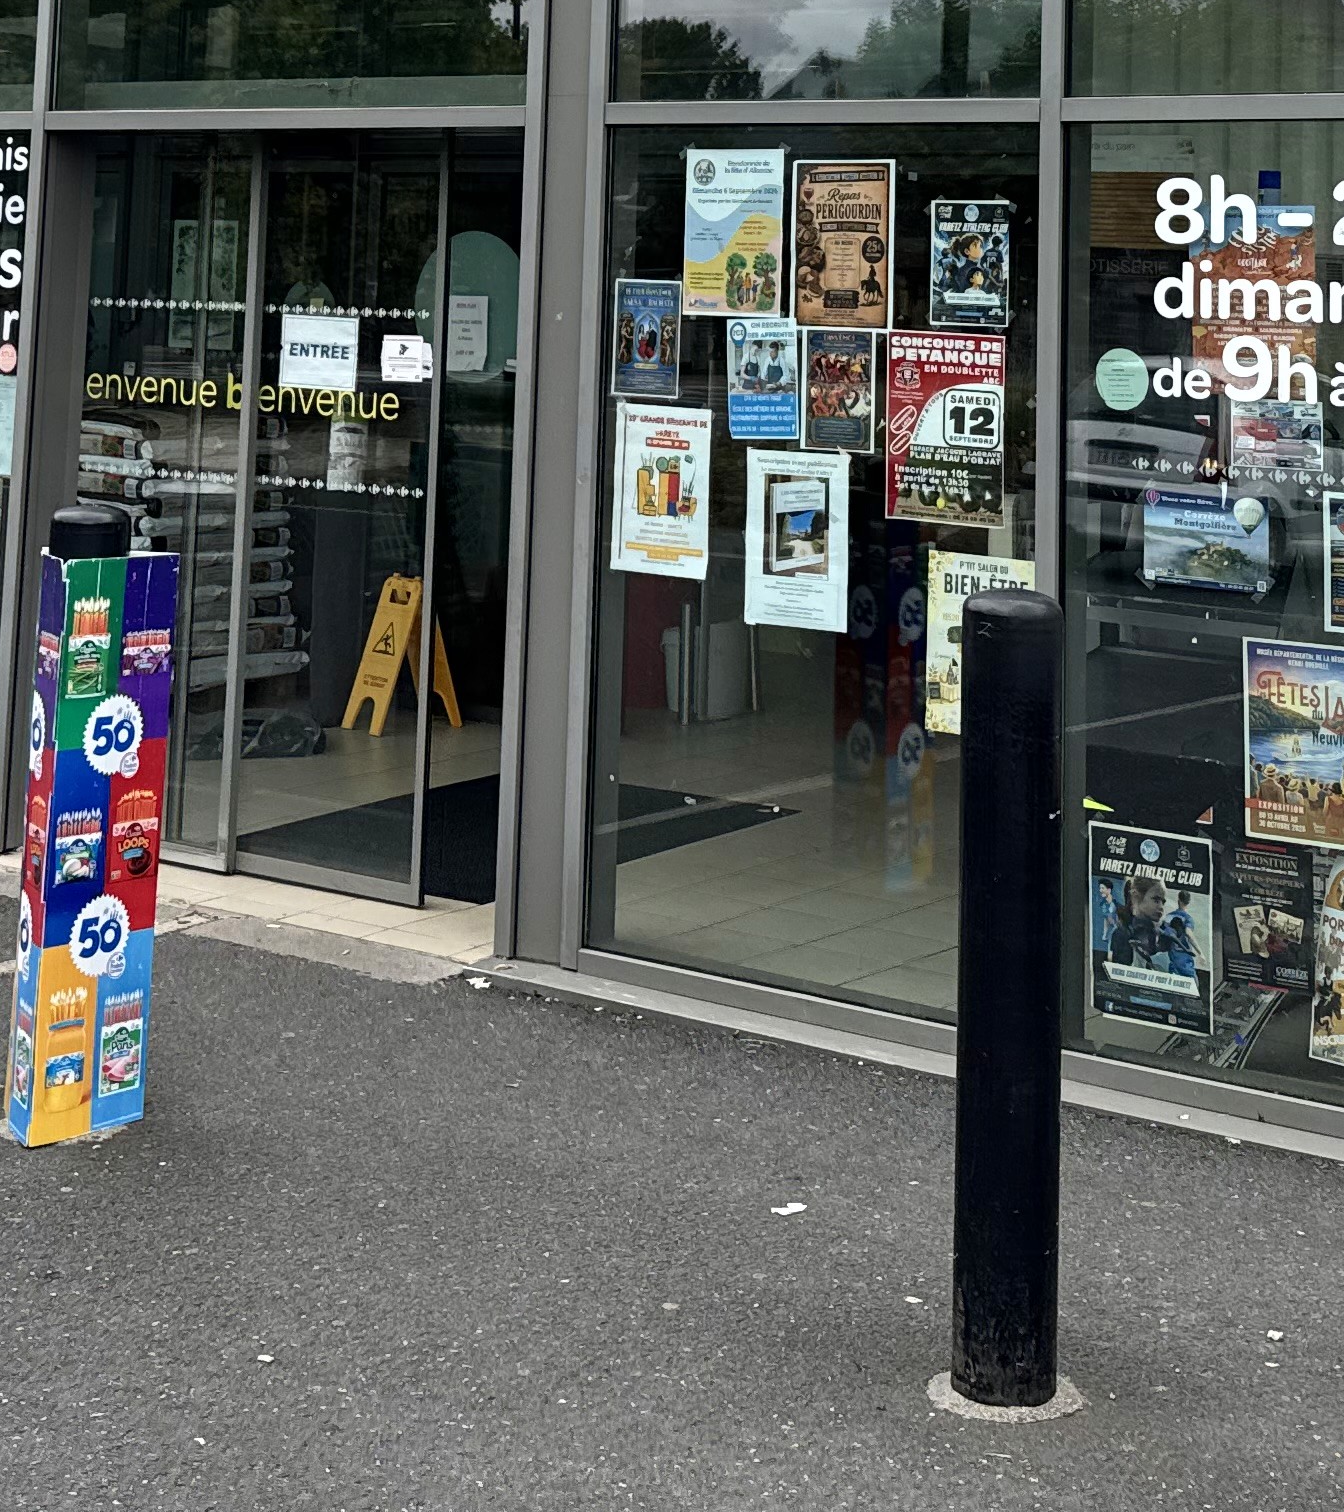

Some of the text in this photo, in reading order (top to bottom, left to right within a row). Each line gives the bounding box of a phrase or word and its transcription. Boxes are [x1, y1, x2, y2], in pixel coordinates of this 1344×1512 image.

[825, 188, 860, 203] Repas
[1154, 175, 1256, 244] 8h
[289, 341, 350, 360] ENTRÉE
[891, 336, 975, 350] CONCOURS
[891, 347, 1002, 366] PETANQUE
[1153, 357, 1211, 400] de
[1222, 335, 1318, 405] 9h
[86, 371, 400, 421] envenue benvenue
[950, 395, 996, 406] SAMEDI
[949, 406, 994, 436] 12
[895, 464, 947, 477] Inscription
[1184, 510, 1226, 521] Corrèze
[1256, 670, 1321, 710] FÊTES
[92, 716, 135, 756] 50
[1258, 800, 1304, 815] EXPOSITION
[117, 837, 151, 854] LOOPS
[1235, 852, 1298, 871] EXPOSITION
[1134, 863, 1204, 887] ATHLETIC CLUB
[78, 916, 122, 958] 50
